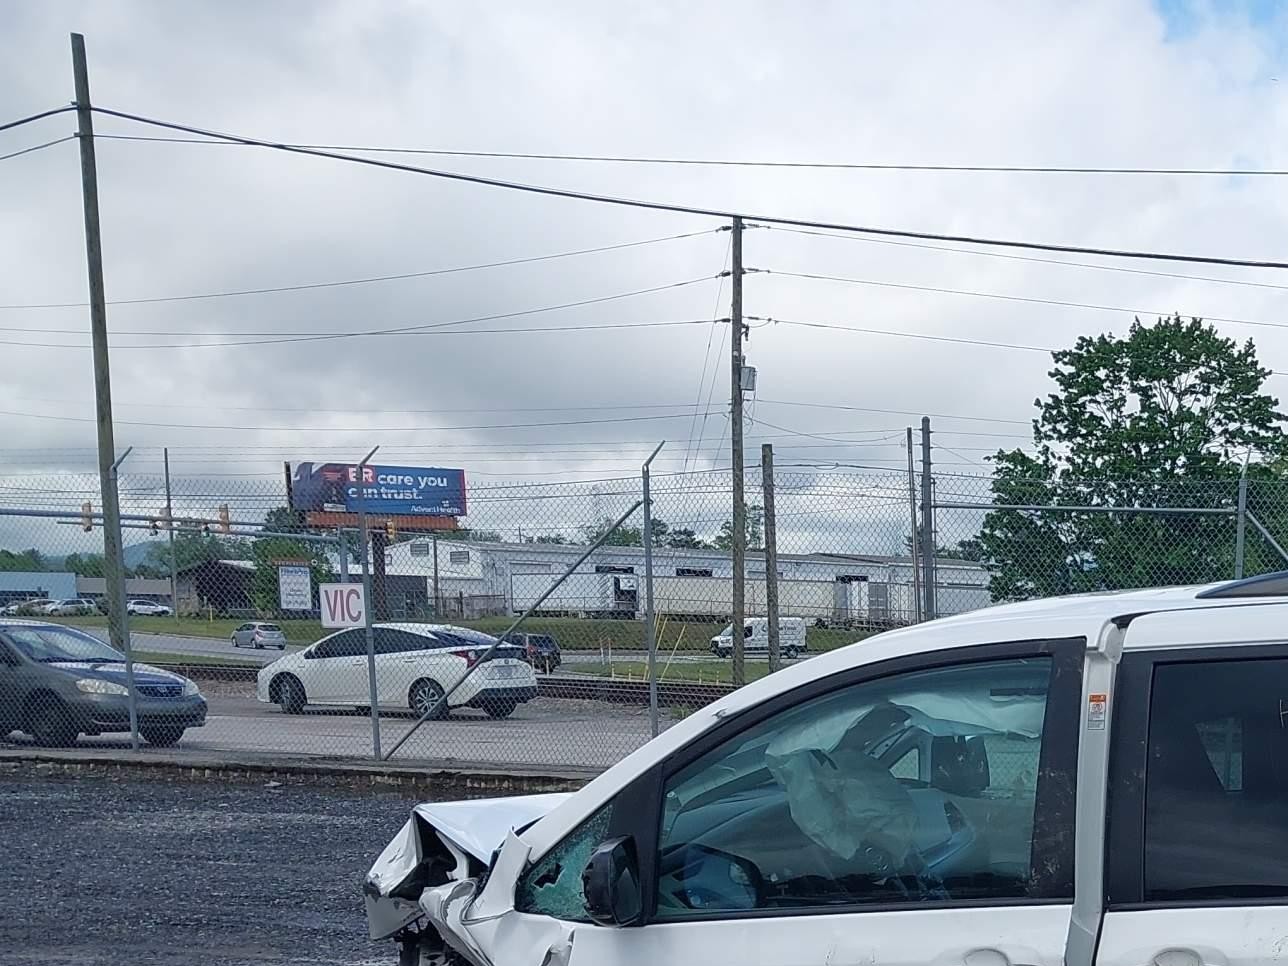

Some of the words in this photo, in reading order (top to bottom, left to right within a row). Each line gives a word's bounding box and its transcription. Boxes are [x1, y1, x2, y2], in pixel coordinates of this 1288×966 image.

[348, 467, 374, 482] ER
[377, 474, 414, 485] care
[417, 475, 448, 489] you
[380, 487, 423, 500] trust.
[323, 588, 362, 623] VIC
